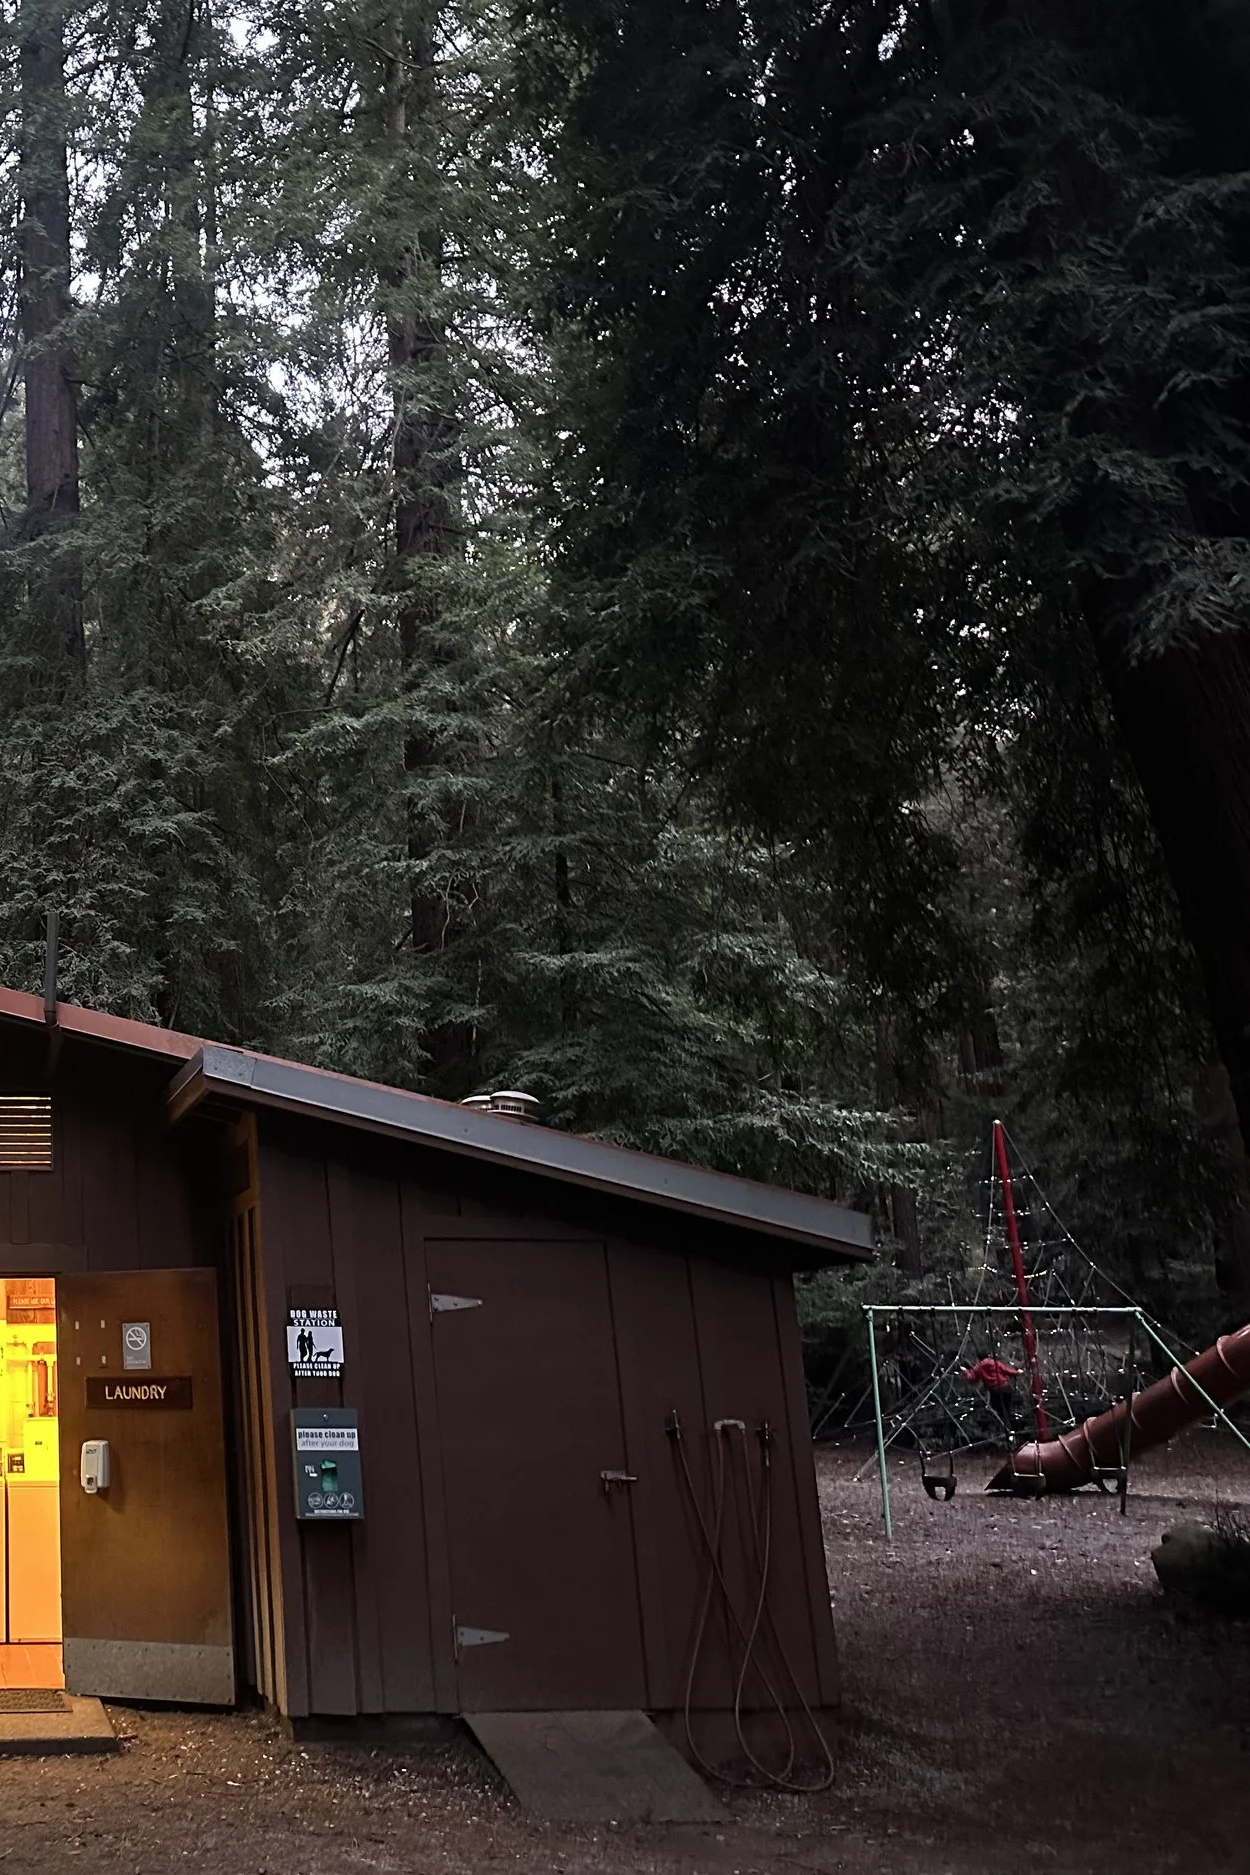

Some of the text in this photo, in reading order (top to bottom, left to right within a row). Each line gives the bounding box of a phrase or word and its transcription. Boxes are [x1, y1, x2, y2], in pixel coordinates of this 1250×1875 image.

[290, 1309, 338, 1319] DOG WASTE
[293, 1319, 336, 1327] STATION
[105, 1385, 167, 1400] LAUNDRY
[298, 1430, 356, 1440] please clean up
[301, 1439, 319, 1447] after
[339, 1439, 355, 1448] dog
